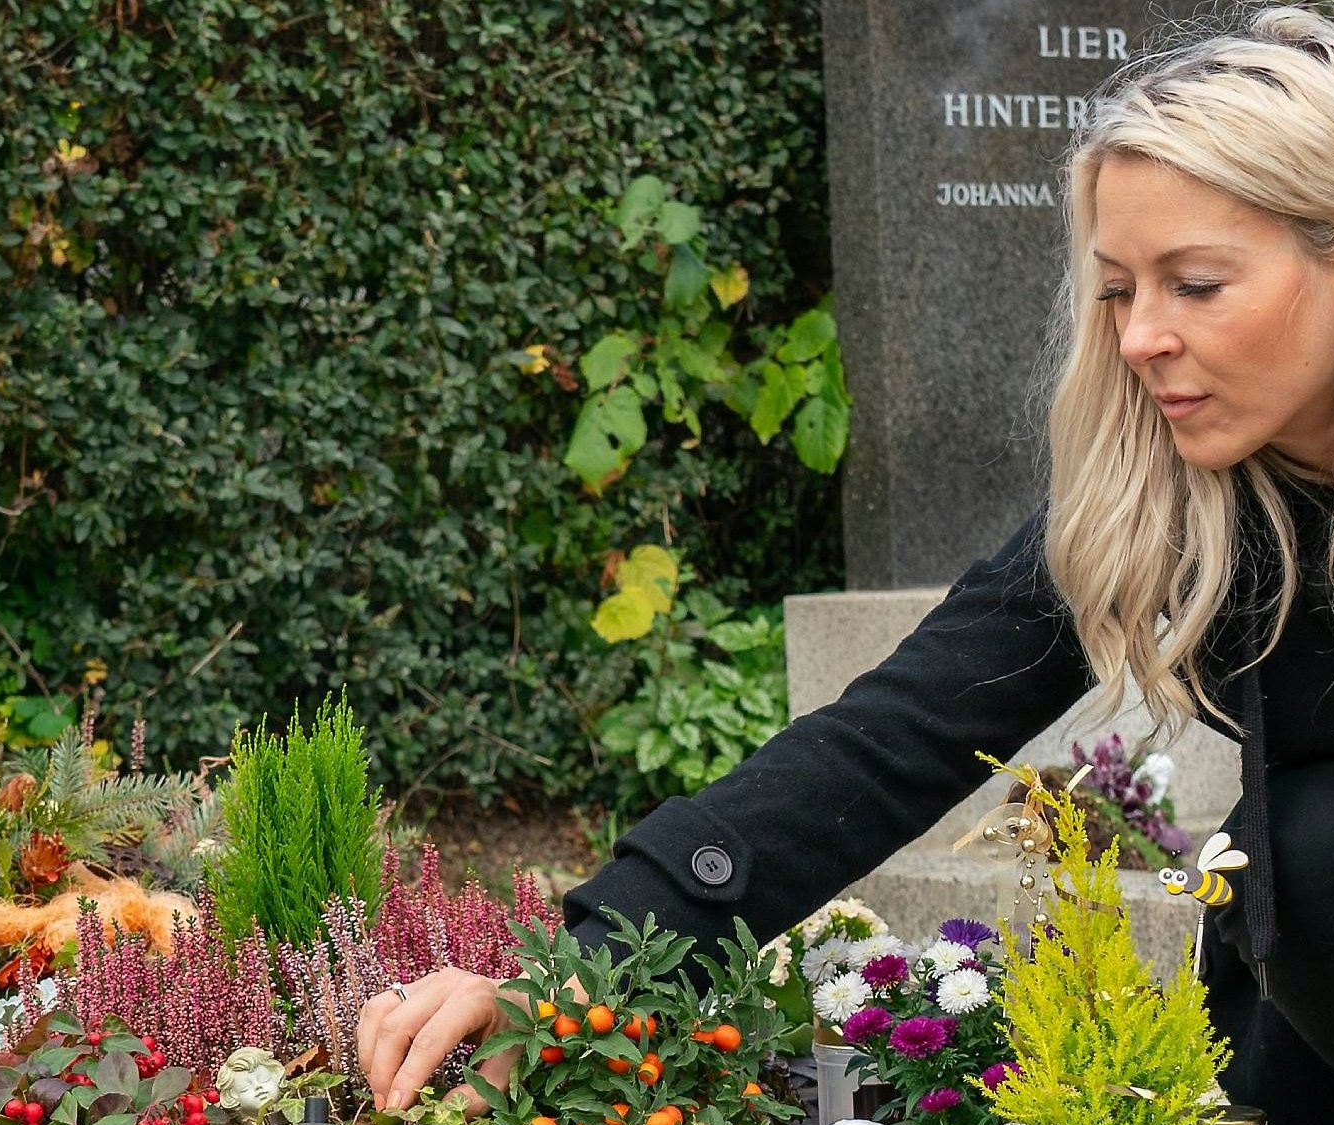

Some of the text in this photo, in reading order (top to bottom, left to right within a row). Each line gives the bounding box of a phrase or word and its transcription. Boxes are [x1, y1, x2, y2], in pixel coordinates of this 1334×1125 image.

[1038, 25, 1128, 60] LIER
[943, 93, 1091, 129] HINTER
[937, 182, 1055, 206] JOHANNA
